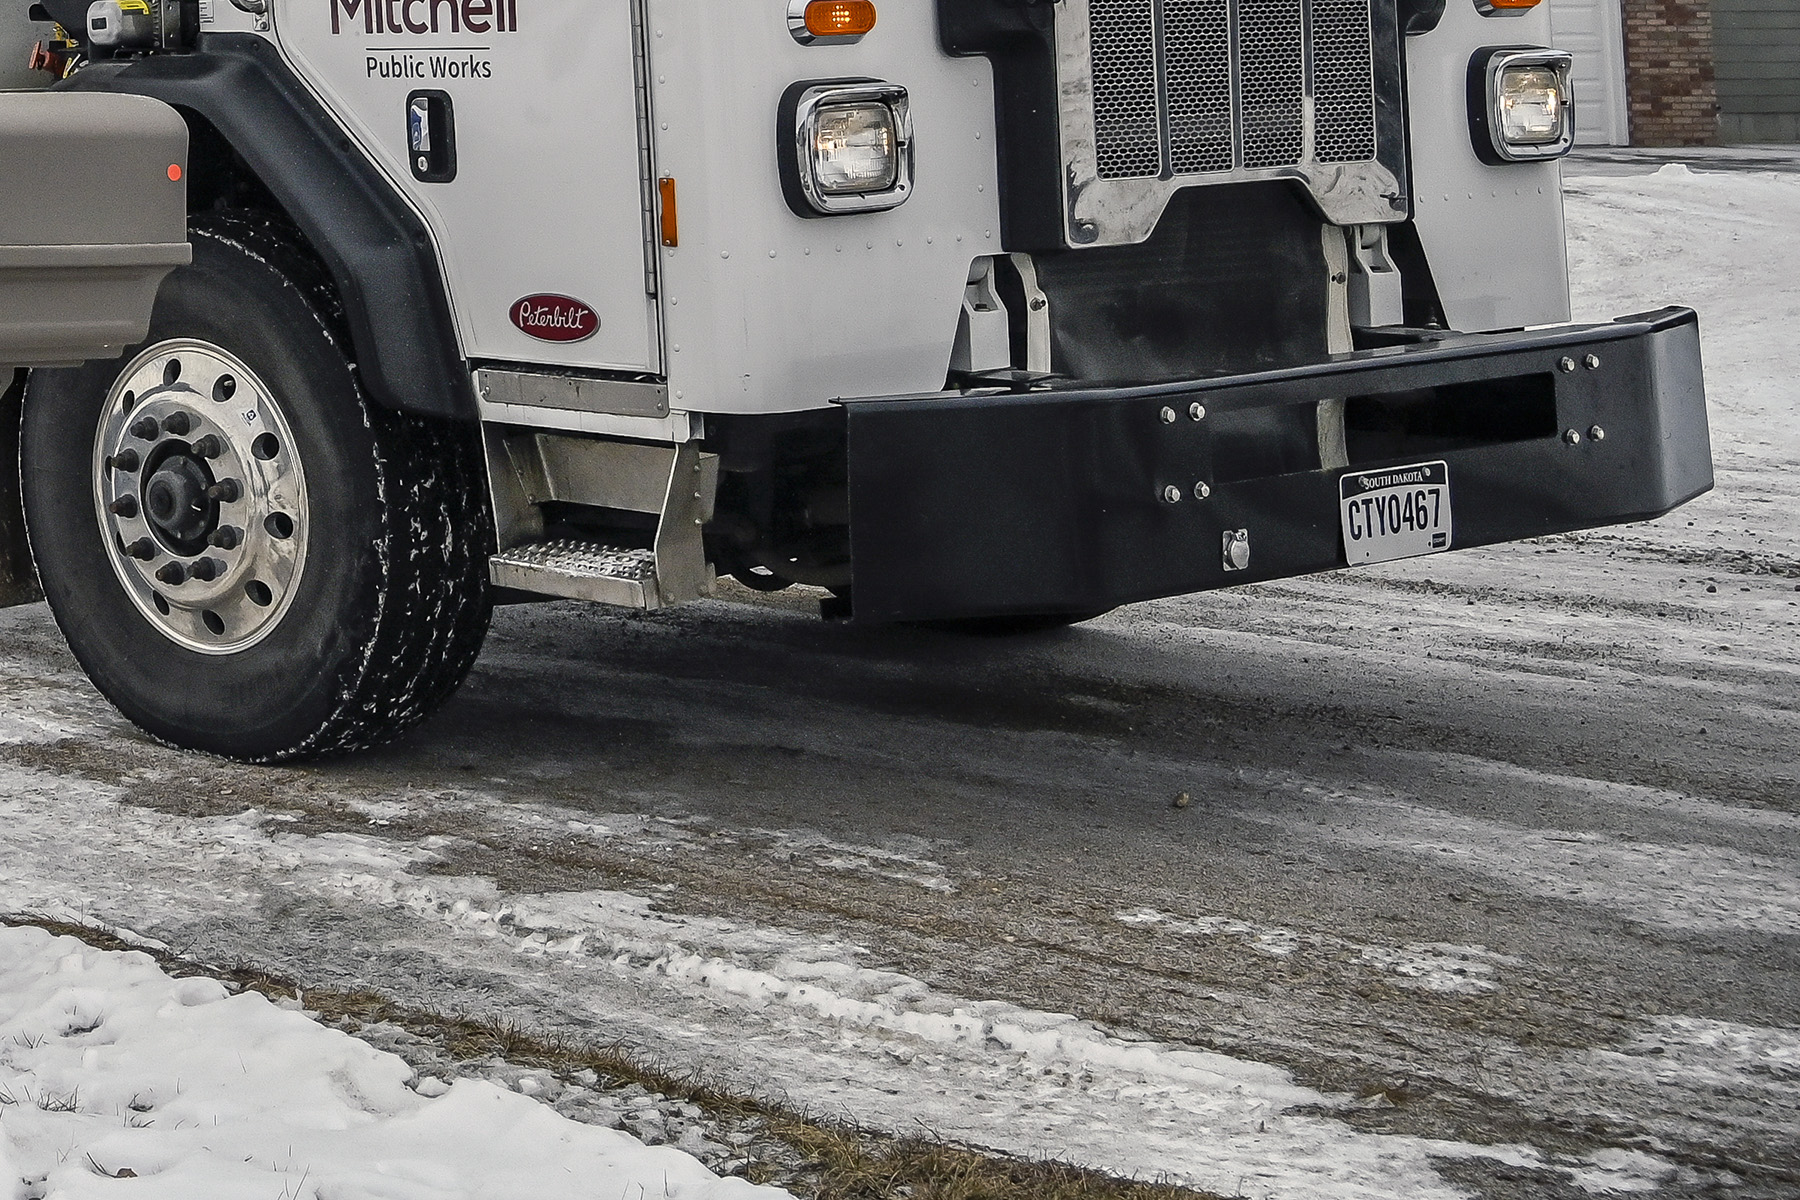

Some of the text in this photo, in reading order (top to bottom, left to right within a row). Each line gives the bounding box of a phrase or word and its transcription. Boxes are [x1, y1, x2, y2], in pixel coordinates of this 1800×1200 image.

[365, 54, 492, 79] Public Works
[519, 301, 589, 329] Peterbilt
[1365, 471, 1423, 490] SOUTH DAKOTA
